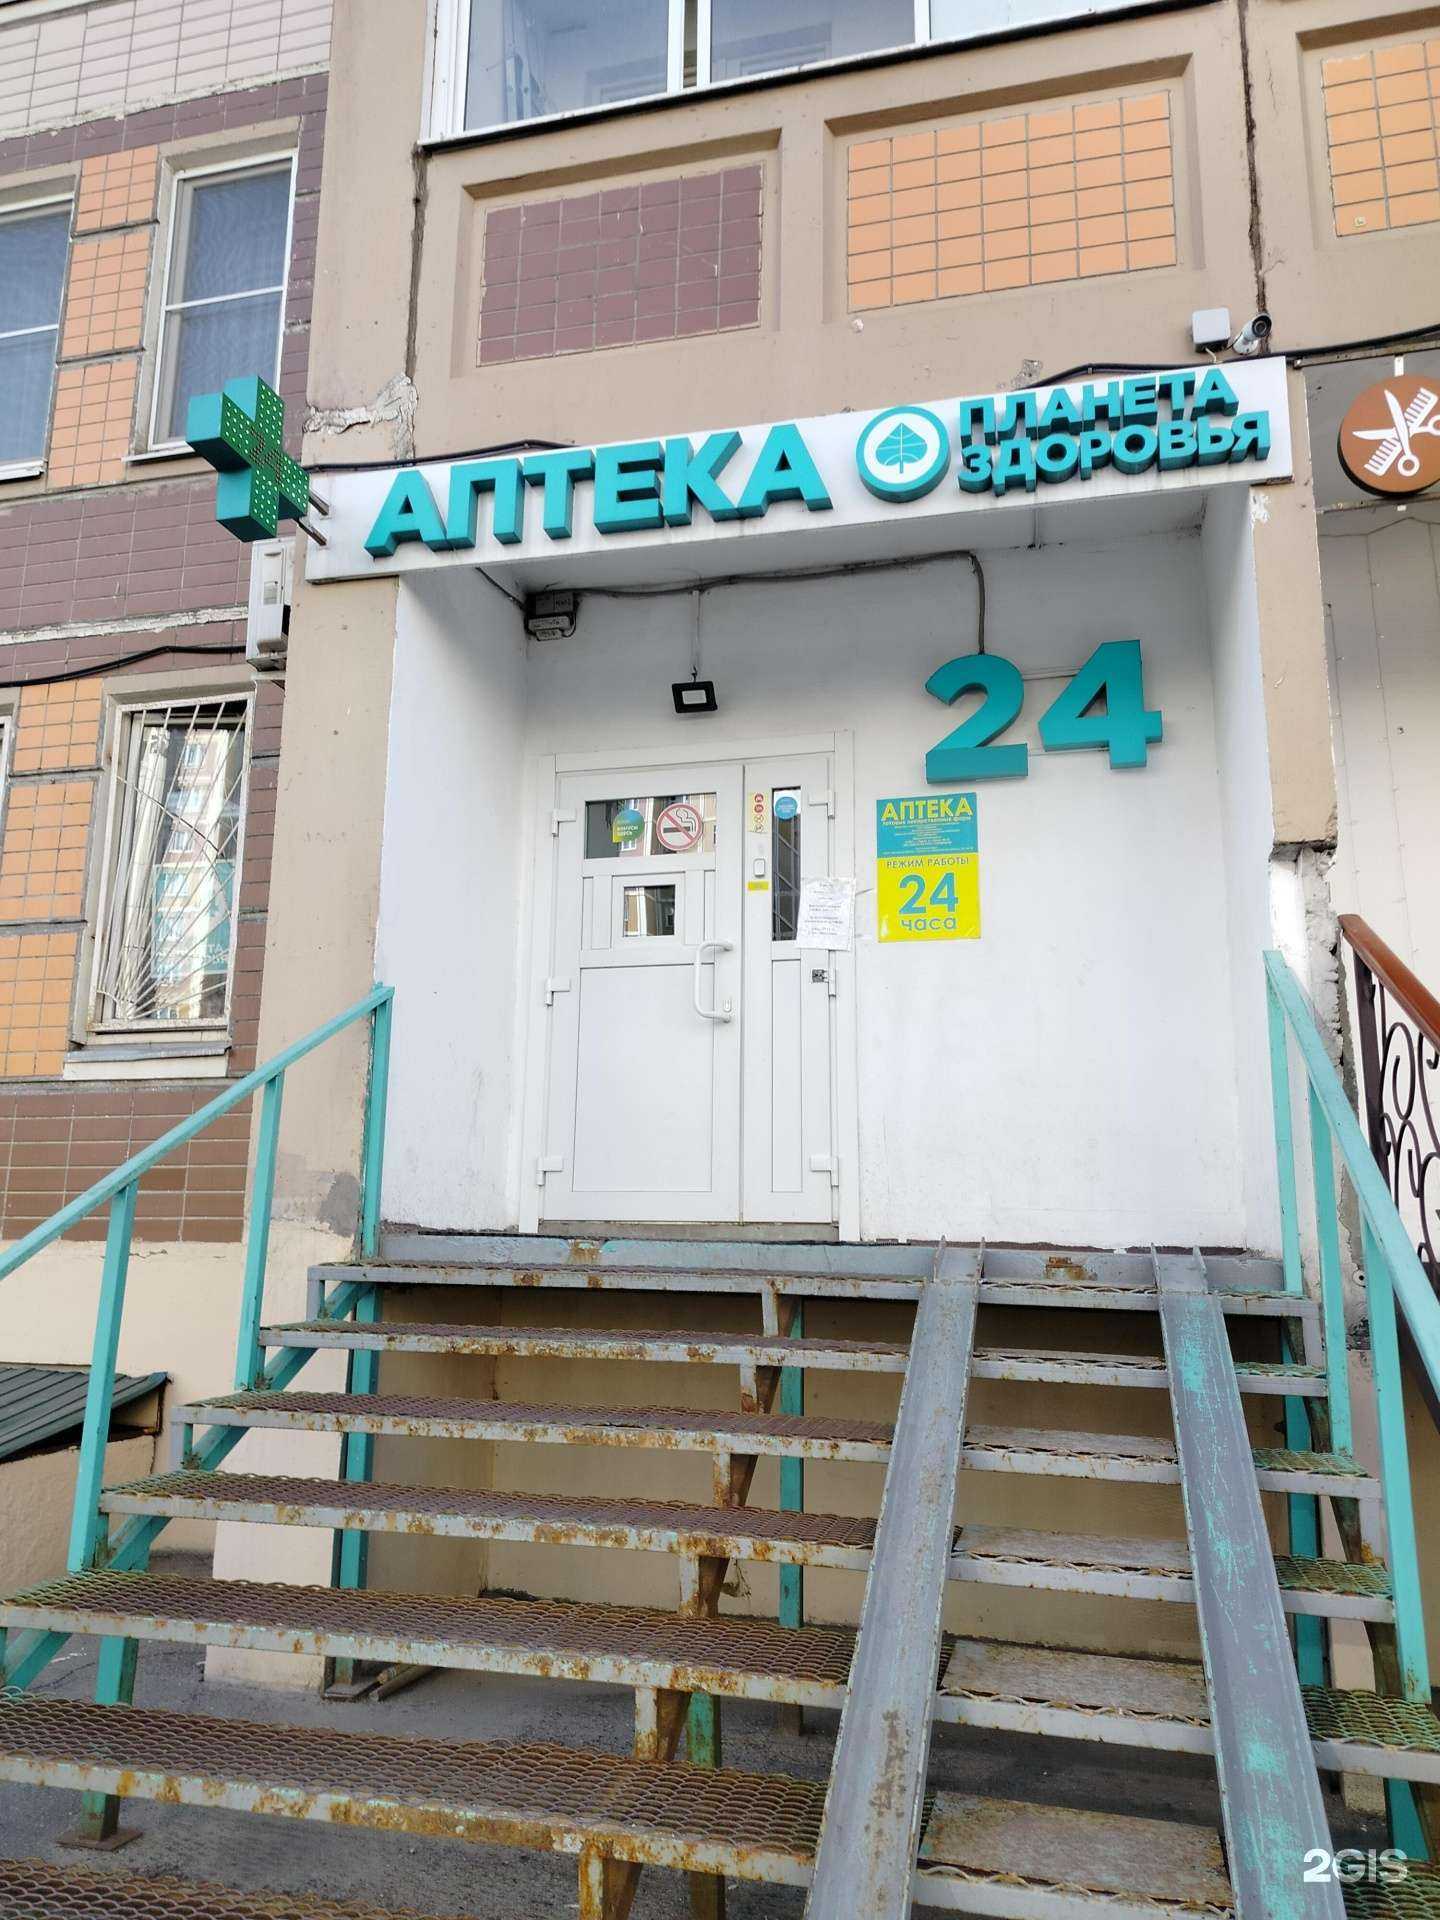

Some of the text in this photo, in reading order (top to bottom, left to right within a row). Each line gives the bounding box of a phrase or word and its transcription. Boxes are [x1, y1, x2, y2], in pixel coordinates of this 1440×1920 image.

[960, 368, 1239, 446] ПЛАНЕТА
[364, 424, 833, 558] АПТЕКА
[958, 410, 1272, 497] ЗДОРОВЬЯ
[925, 639, 1163, 784] 24
[881, 797, 974, 821] АПТЕКА
[886, 857, 969, 870] РЕЖИМ РАБОТЫ
[898, 872, 959, 915] 24
